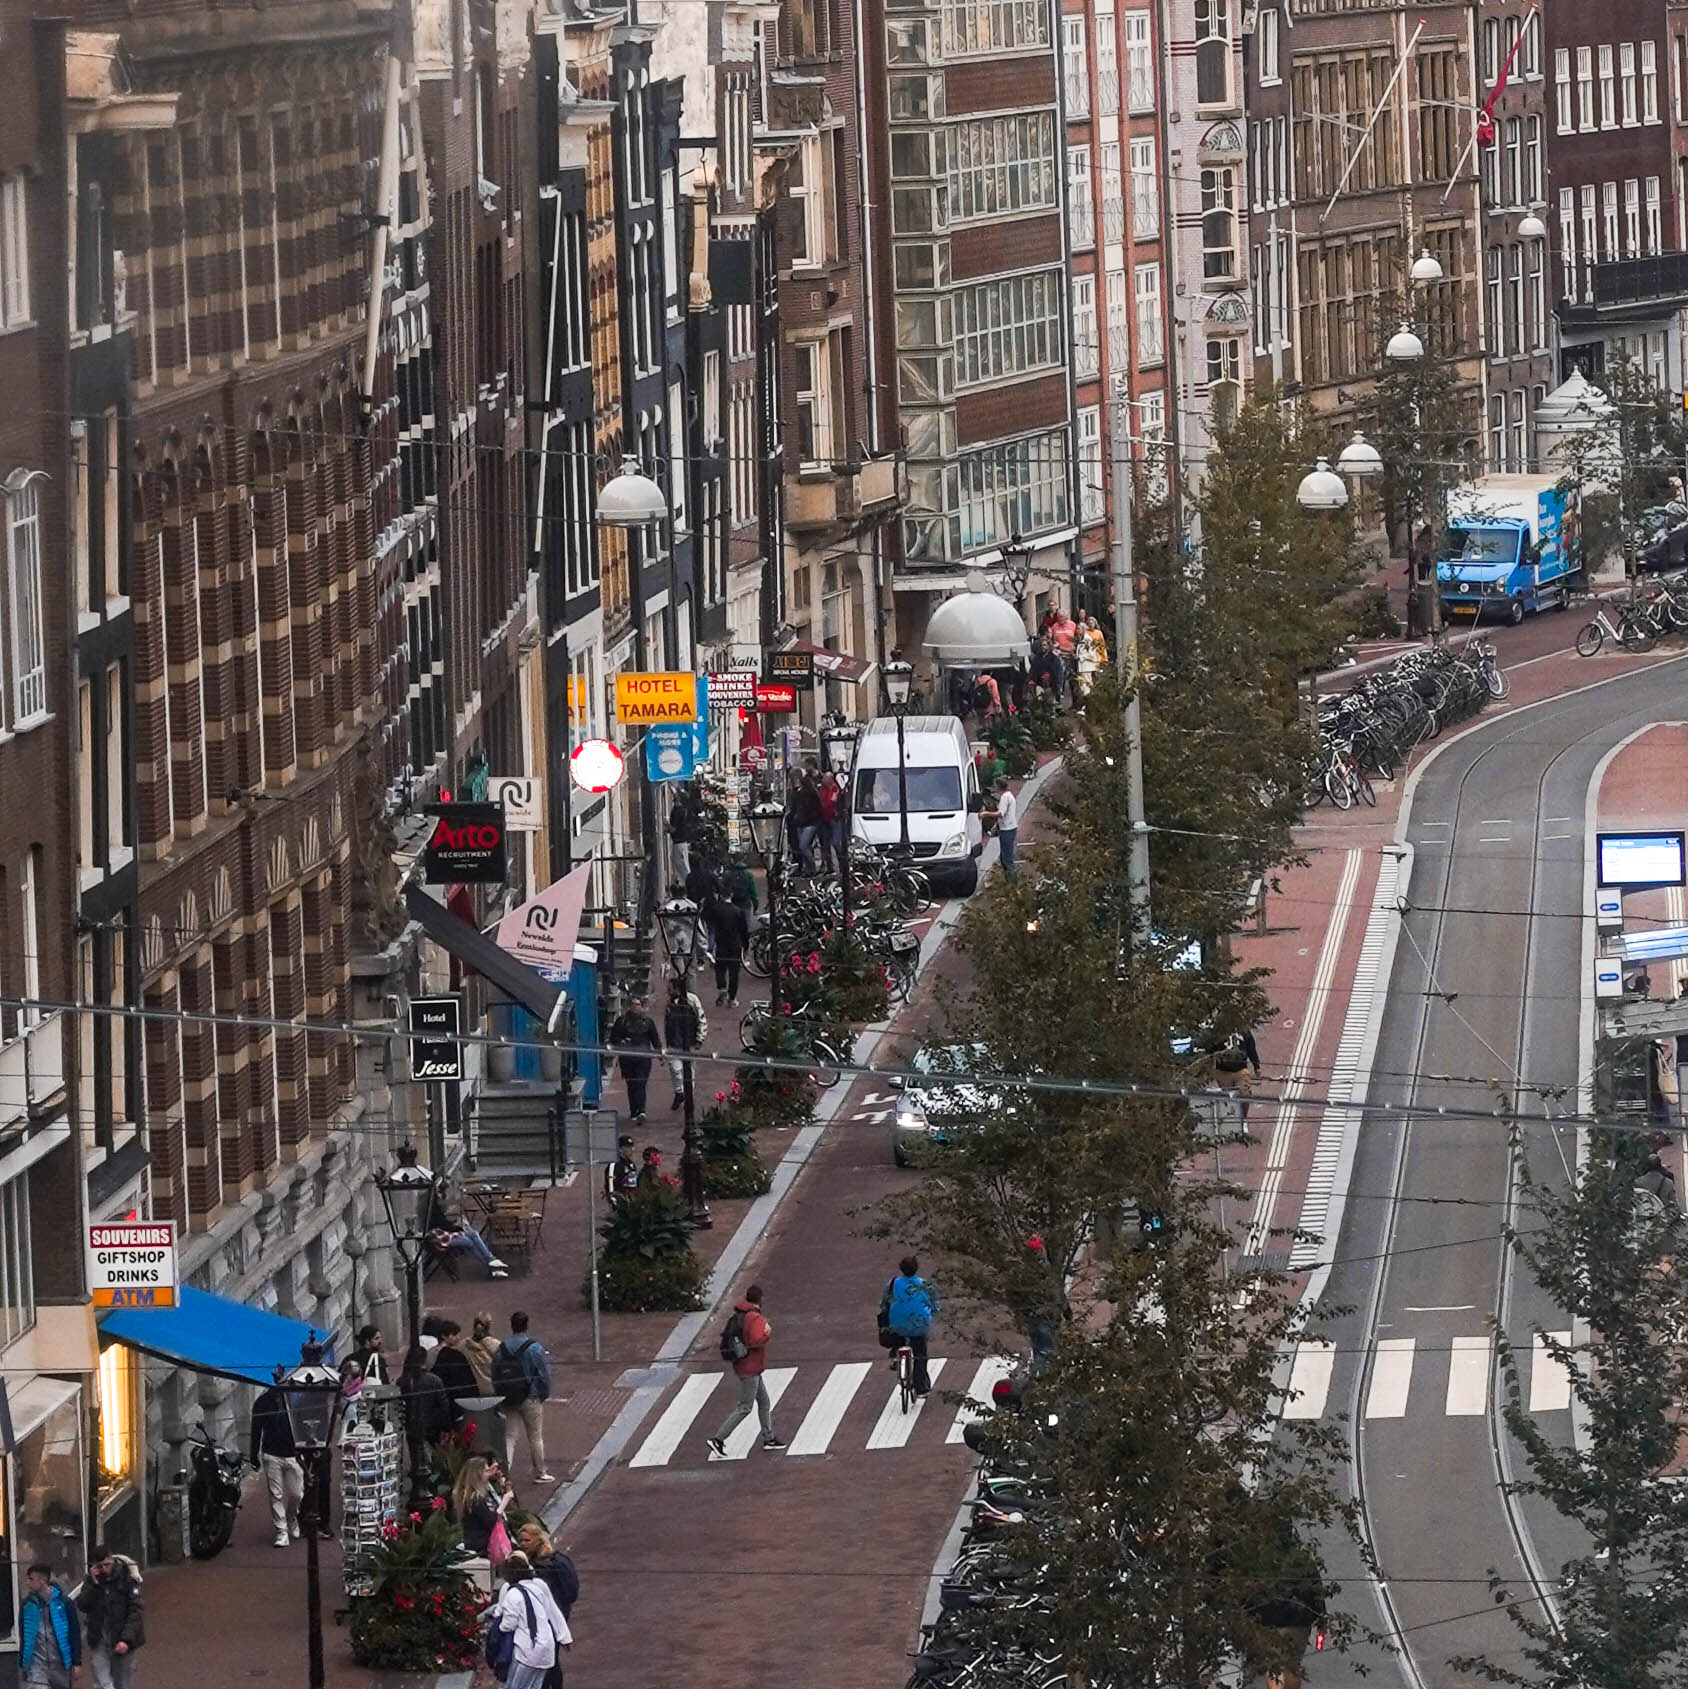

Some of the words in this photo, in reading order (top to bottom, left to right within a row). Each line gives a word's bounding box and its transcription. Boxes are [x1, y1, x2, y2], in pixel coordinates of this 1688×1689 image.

[626, 679, 683, 694] HOTEL
[619, 702, 692, 718] TAMARA
[708, 699, 755, 708] TOBACCO
[432, 819, 500, 849] Arto
[438, 851, 492, 859] RECRUITMENT
[423, 1012, 446, 1023] Hotel
[414, 1059, 458, 1078] Jesse
[91, 1228, 170, 1246] SOUVENIRS
[97, 1250, 166, 1264] GIFTSHOP
[107, 1268, 159, 1283] DRINKS
[111, 1288, 154, 1306] ATM
